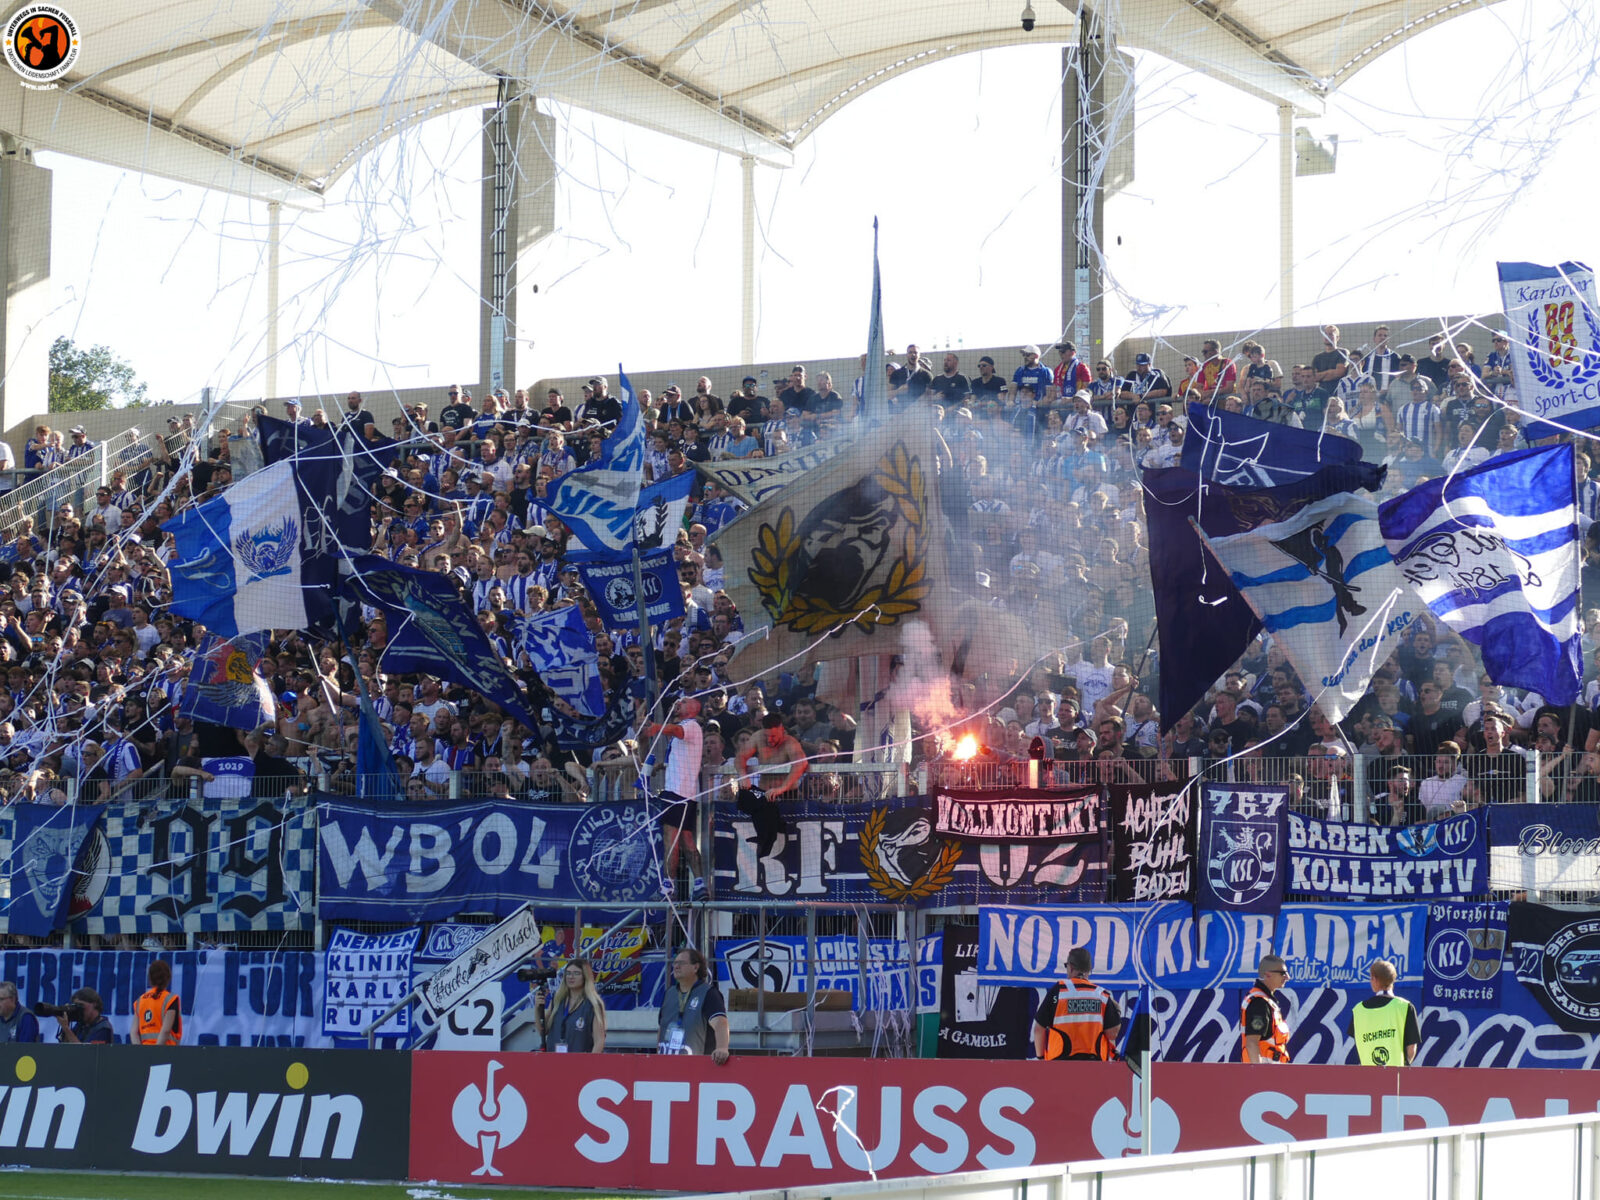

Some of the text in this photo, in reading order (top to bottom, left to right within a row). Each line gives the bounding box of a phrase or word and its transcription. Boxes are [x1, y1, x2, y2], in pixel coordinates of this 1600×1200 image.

[577, 808, 615, 846] WILD
[1117, 787, 1191, 840] ACHERN
[1288, 814, 1471, 855] BADEN KSC
[1126, 861, 1190, 901] BADEN
[1230, 858, 1255, 882] KSC
[1290, 856, 1478, 895] KOLLEKTIV
[1433, 904, 1508, 923] Pforzheim
[334, 930, 420, 951] NERVEN
[985, 912, 1131, 976] NORD
[1238, 910, 1414, 975] BADEN
[329, 953, 408, 972] KLINIK
[1438, 940, 1465, 969] KSC
[1290, 956, 1321, 981] steht
[328, 981, 407, 999] KARLS
[1433, 984, 1494, 1001] Enzkreis
[447, 999, 494, 1036] C2
[1068, 1000, 1101, 1013] SICHERHEIT
[952, 1030, 1007, 1048] GAMBLE
[1362, 1028, 1397, 1043] SICHERHEIT
[131, 1062, 364, 1160] bwin
[574, 1078, 1037, 1174] STRAUSS
